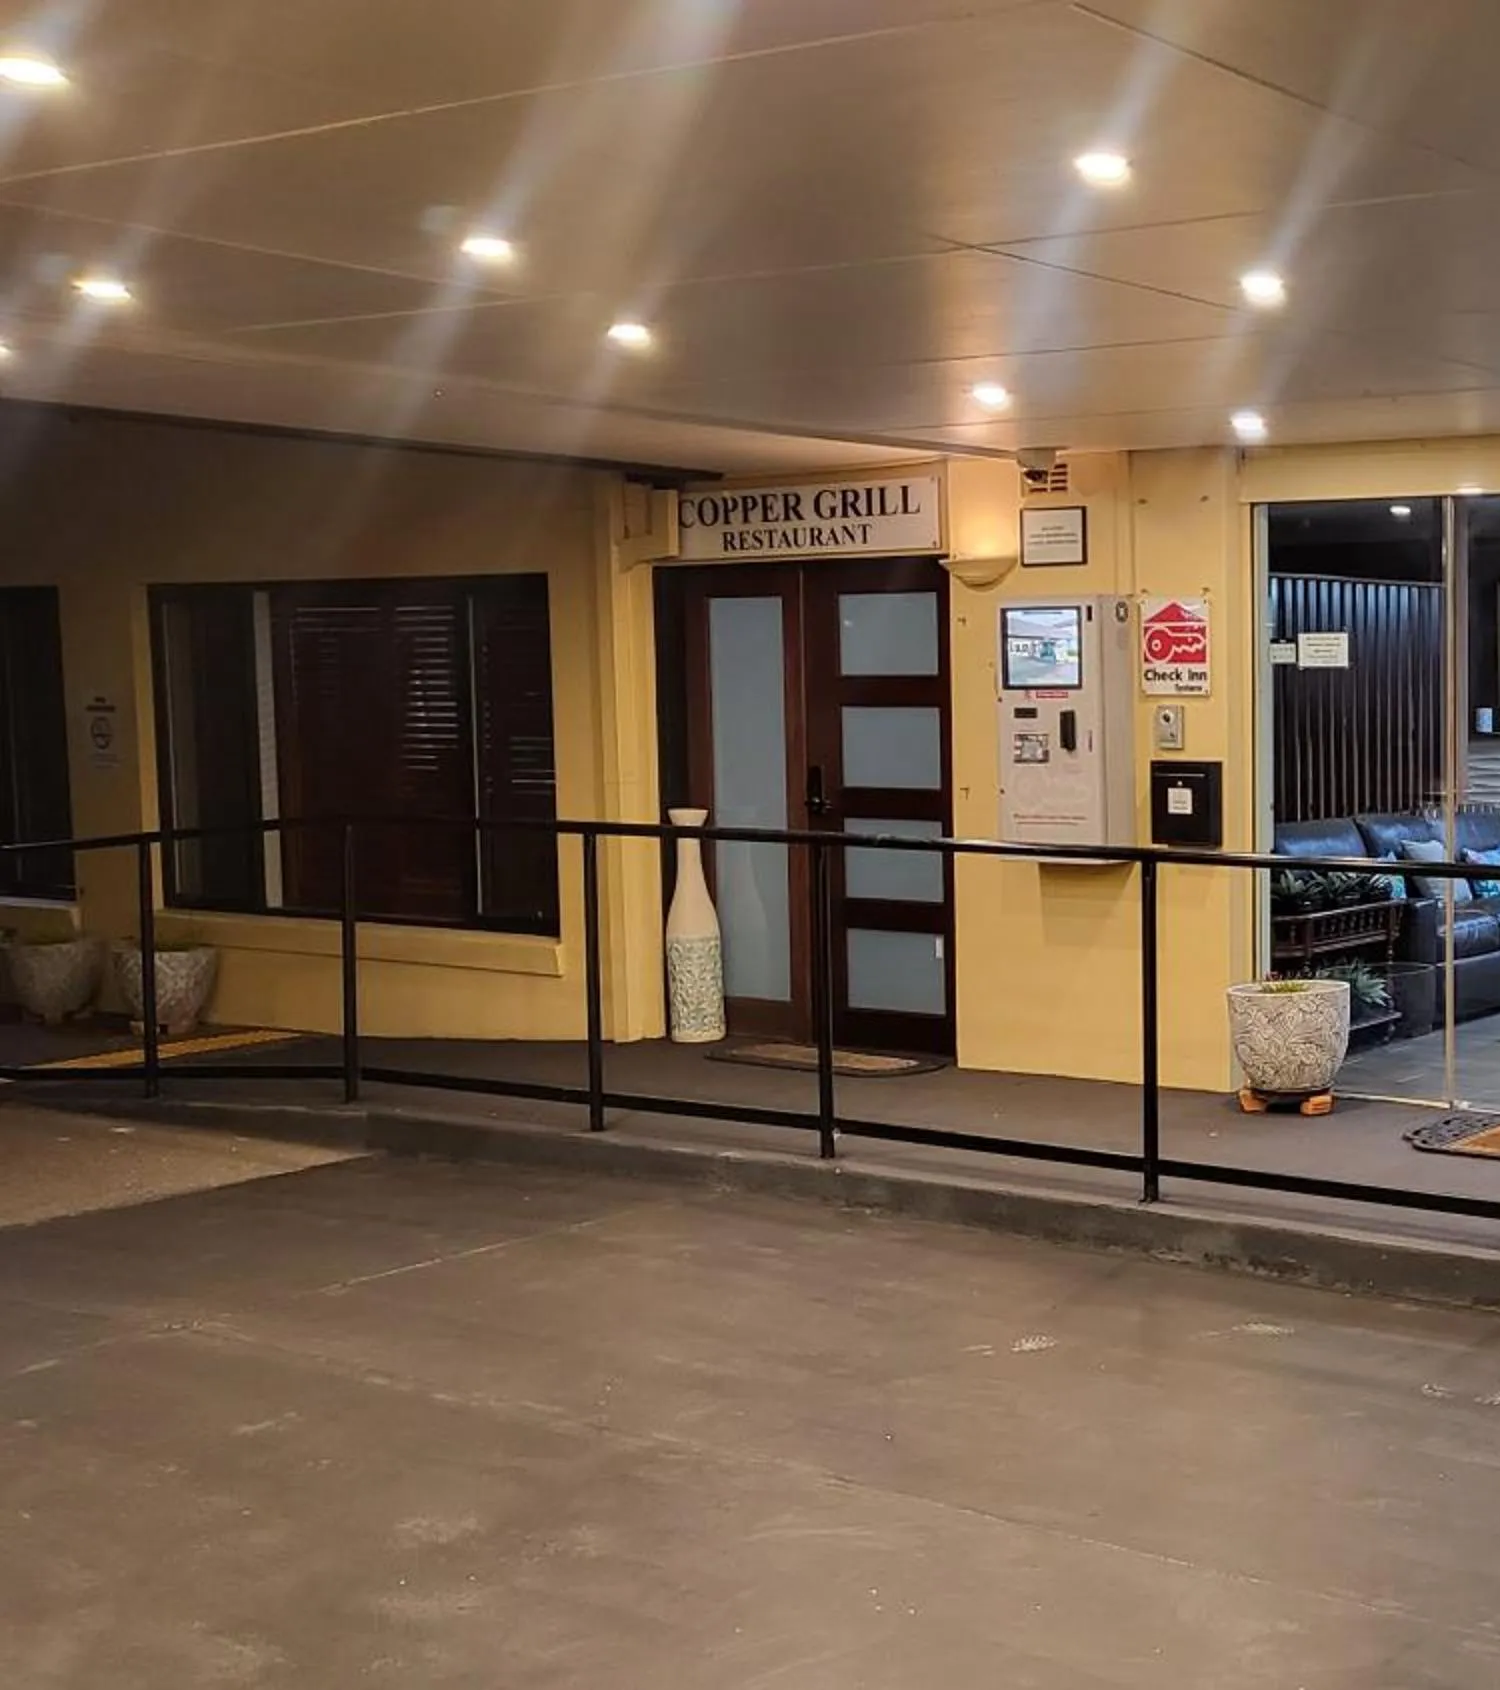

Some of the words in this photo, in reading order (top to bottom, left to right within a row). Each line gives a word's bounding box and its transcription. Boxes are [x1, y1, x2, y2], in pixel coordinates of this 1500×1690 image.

[679, 491, 805, 529] COPPER
[813, 485, 921, 520] GRILL
[723, 524, 873, 552] RESTAURANT
[1143, 667, 1183, 681] Check
